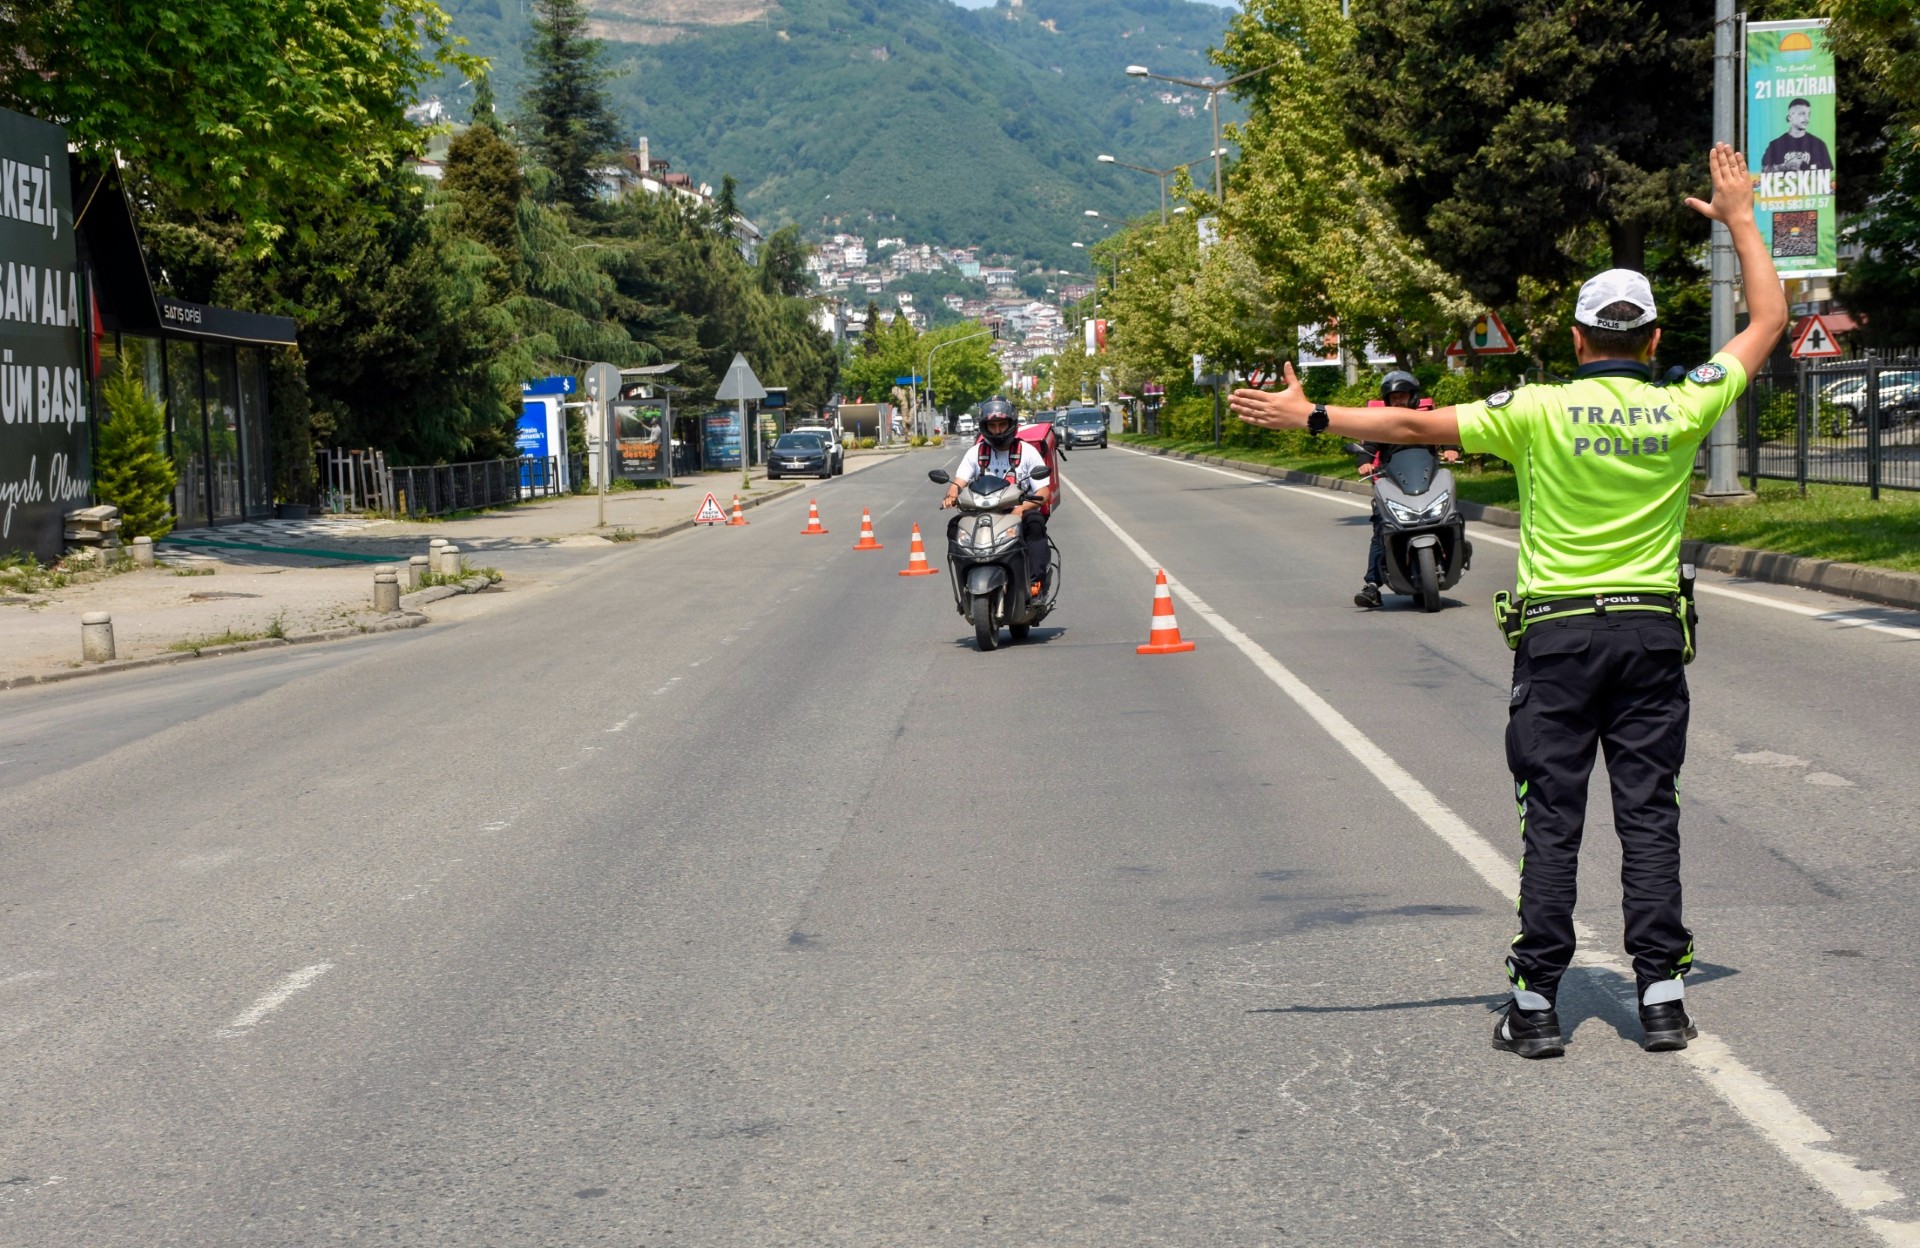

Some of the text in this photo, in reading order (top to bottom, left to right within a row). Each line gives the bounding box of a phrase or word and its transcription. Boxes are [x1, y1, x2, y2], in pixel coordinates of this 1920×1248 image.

[1755, 80, 1771, 99] 21
[1761, 164, 1831, 198] KESKİN
[0, 154, 58, 240] KEZİ,
[42, 268, 80, 327] ALA
[164, 304, 184, 324] SATIŞ
[1597, 319, 1620, 329] POLİS
[38, 366, 86, 434] BAŞL
[1568, 404, 1673, 426] TRAFİK
[1574, 434, 1668, 456] POLİSİ
[1526, 605, 1552, 616] OLİS
[1603, 596, 1640, 604] POLİS
